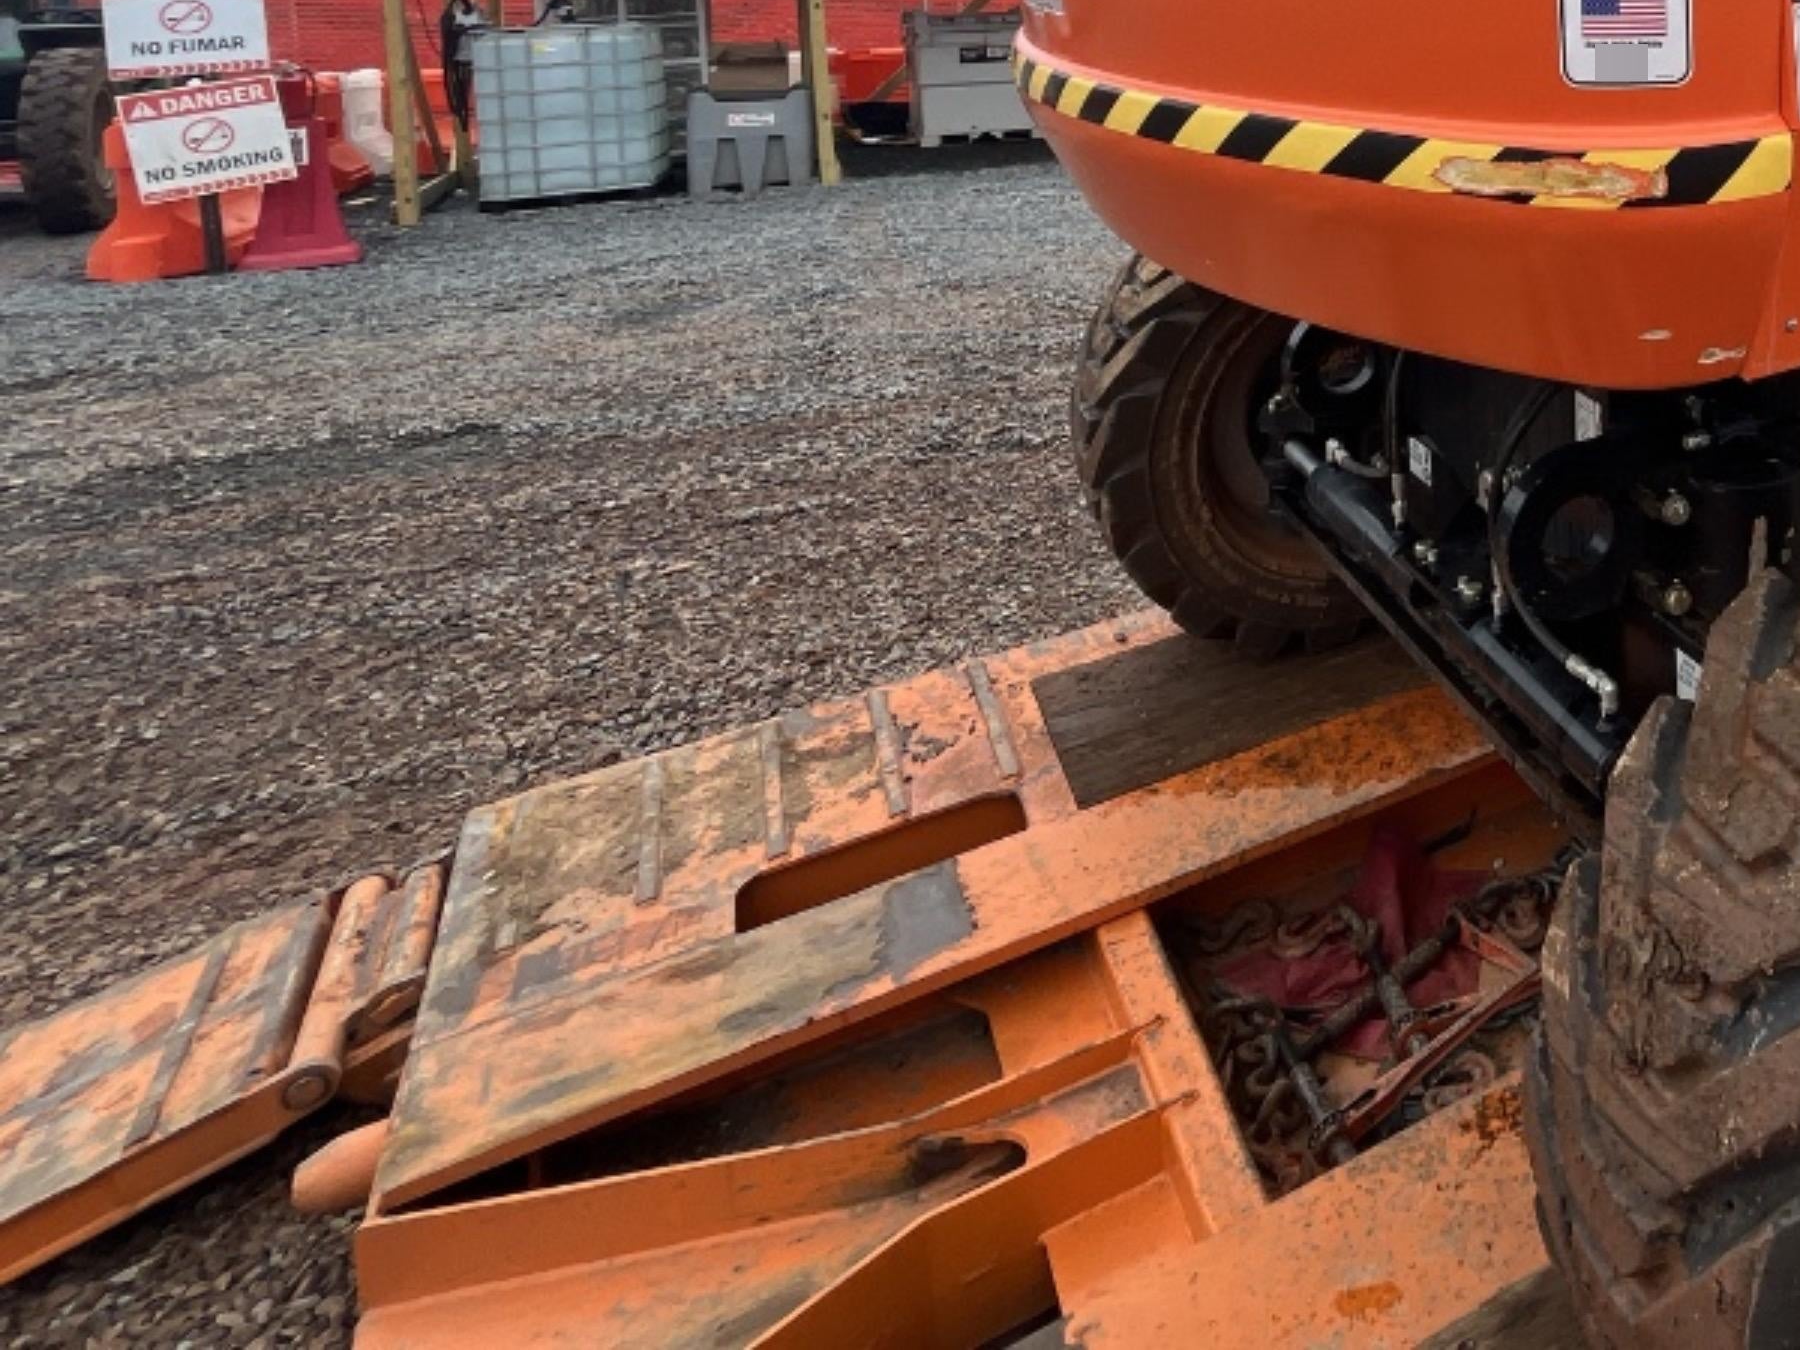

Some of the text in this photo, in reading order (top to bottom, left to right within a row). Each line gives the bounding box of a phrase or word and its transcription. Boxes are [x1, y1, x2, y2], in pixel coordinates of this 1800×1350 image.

[131, 36, 244, 56] NO FUMAR
[159, 84, 268, 114] DANGER
[144, 168, 175, 184] NO
[183, 147, 283, 178] SMOKING
